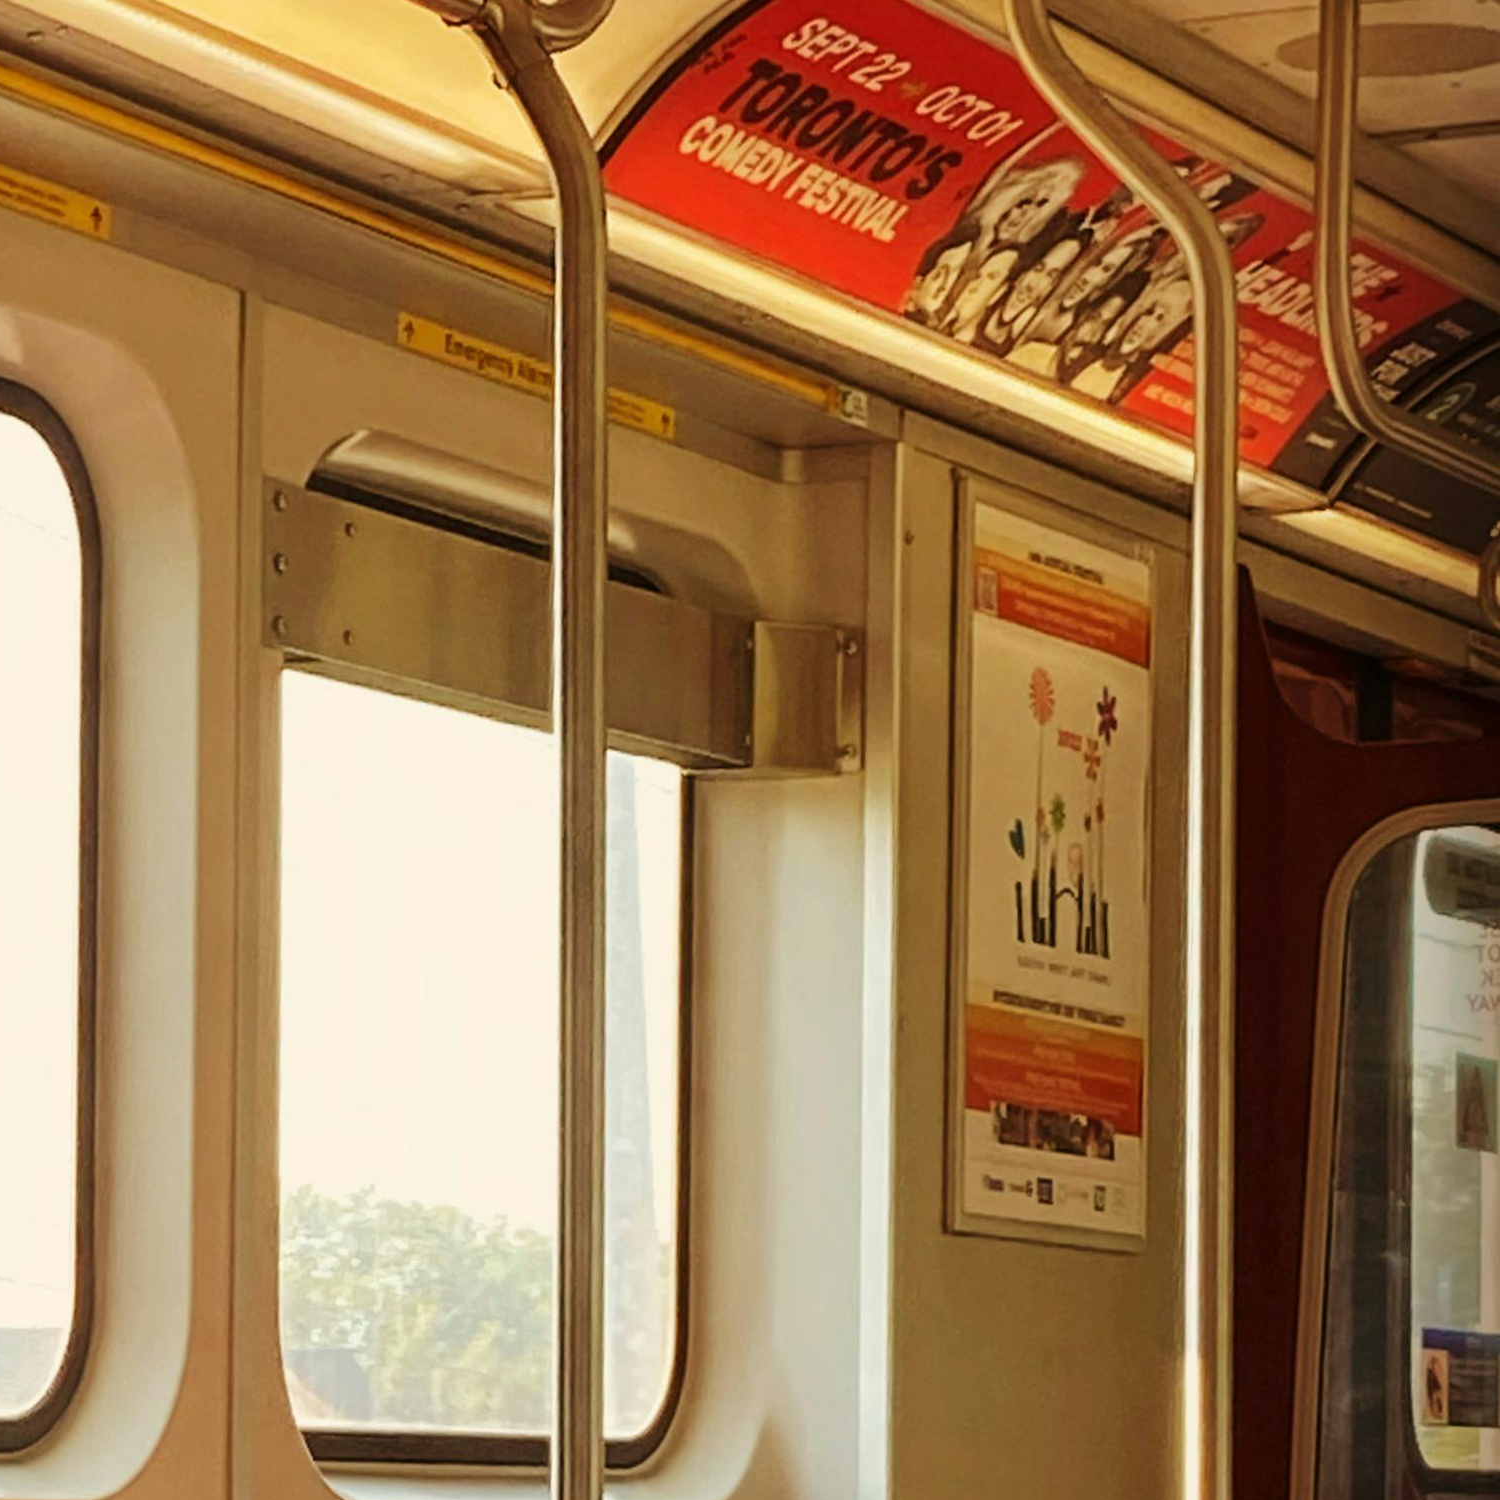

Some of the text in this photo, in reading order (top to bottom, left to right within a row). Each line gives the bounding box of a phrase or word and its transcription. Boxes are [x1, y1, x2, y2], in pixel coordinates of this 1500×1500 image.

[717, 56, 964, 200] TORONTO'S
[782, 17, 878, 74] SEPT
[848, 52, 912, 92] 22
[915, 84, 995, 131] OCT
[966, 110, 1024, 148] 01
[678, 114, 909, 244] COMEDY FESTIVAL
